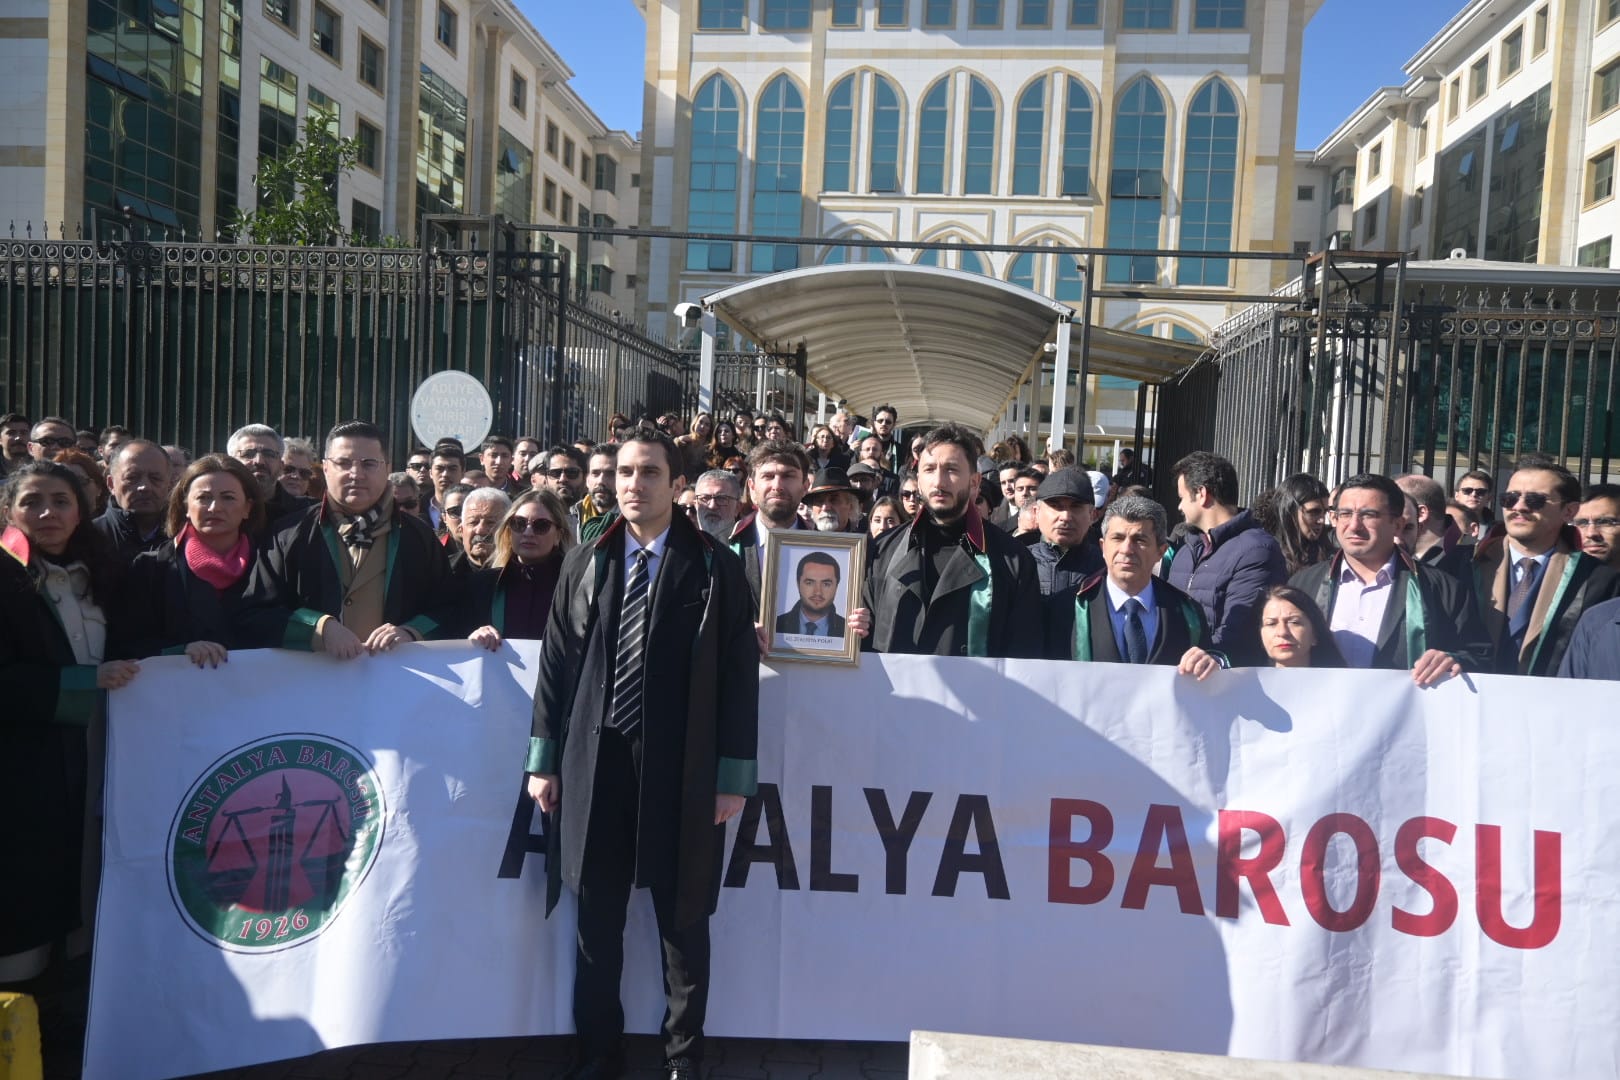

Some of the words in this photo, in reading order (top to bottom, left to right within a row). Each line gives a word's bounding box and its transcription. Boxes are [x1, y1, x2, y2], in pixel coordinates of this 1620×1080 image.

[182, 746, 287, 844] ANTALYA
[296, 745, 373, 820] BAROSU
[497, 771, 1011, 900] AALYA
[1048, 797, 1562, 950] BAROSU
[238, 908, 309, 940] 1926
